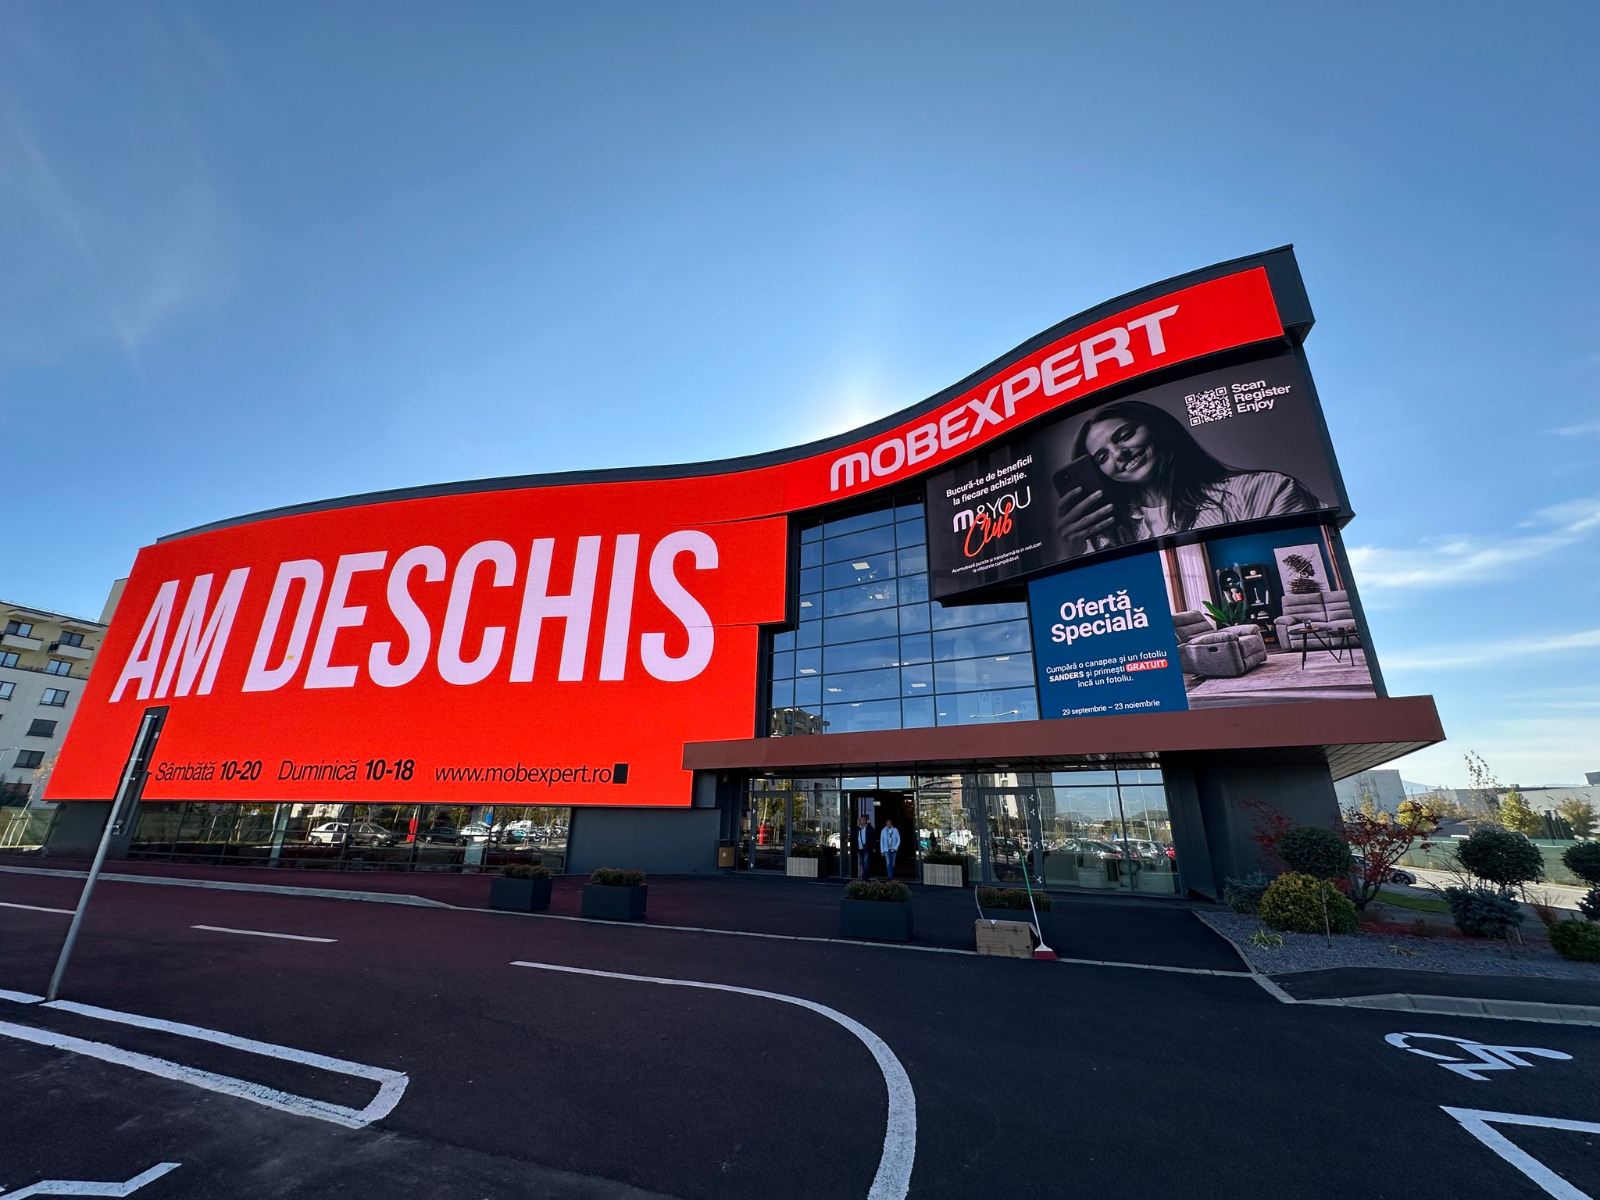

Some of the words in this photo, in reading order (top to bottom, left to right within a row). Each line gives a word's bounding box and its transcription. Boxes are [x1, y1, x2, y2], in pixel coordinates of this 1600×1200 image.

[830, 304, 1180, 492] MOBEXPERT
[1231, 380, 1266, 393] Scan
[1233, 385, 1291, 403] Register
[1236, 399, 1274, 413] Enjoy
[946, 479, 984, 497] Bucură-te
[985, 473, 995, 482] de
[997, 455, 1032, 477] beneficii
[953, 498, 961, 506] la
[962, 487, 989, 502] fiecare
[964, 502, 1012, 557] Club
[109, 567, 250, 703] AM
[242, 530, 719, 692] DESCHIS
[1060, 589, 1131, 621] Ofertă
[1051, 607, 1149, 645] Specială
[1046, 661, 1077, 674] Cumpără
[1085, 658, 1117, 668] canapea
[1127, 654, 1138, 662] un
[1140, 650, 1167, 660] fotoliu
[1049, 671, 1084, 683] SANDERS
[1127, 659, 1166, 671] GRATUIT
[1106, 675, 1134, 684] fotoliu.
[1071, 705, 1107, 716] septembrie
[1124, 700, 1161, 710] noiembrie
[155, 760, 217, 781] Sâmbătă
[219, 760, 262, 781] 10-20
[277, 759, 360, 781] Duminică
[365, 759, 415, 781] 10-18
[435, 762, 612, 787] www.mobexpert.ro
